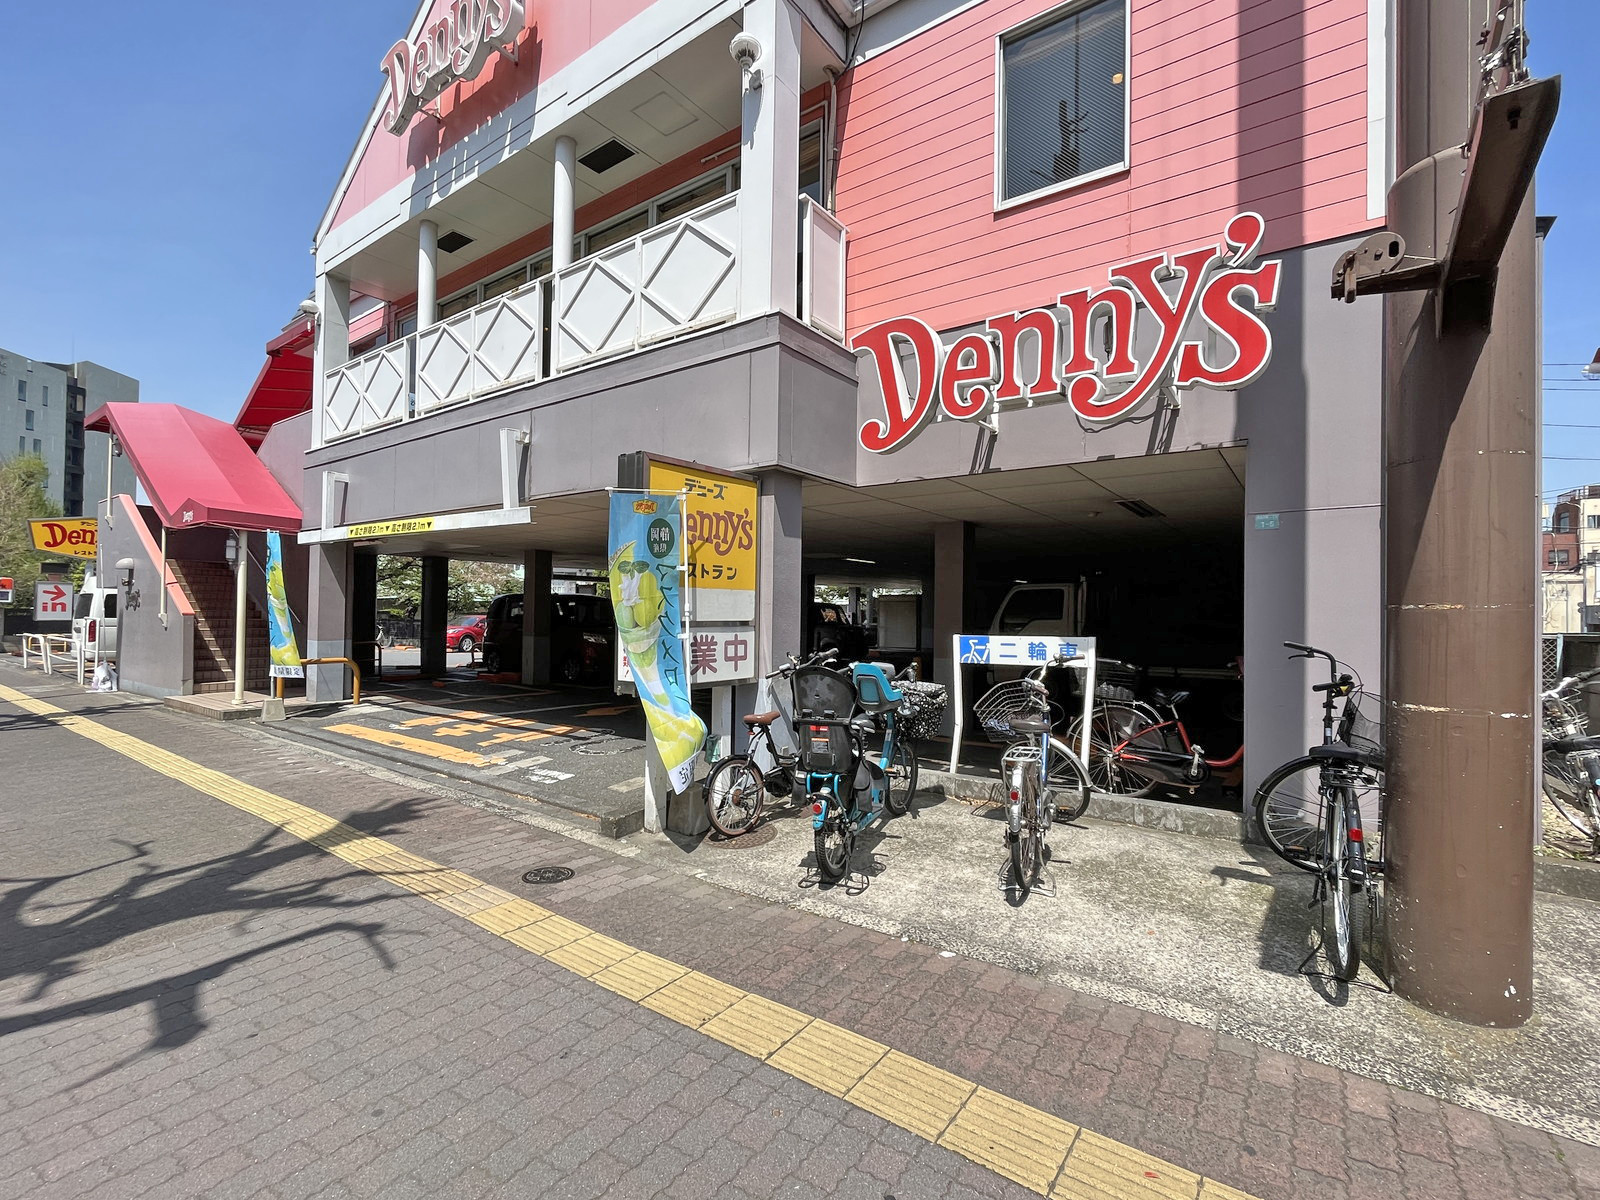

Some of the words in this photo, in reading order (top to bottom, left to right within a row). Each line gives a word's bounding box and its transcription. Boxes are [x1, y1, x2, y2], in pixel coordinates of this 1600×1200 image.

[380, 0, 520, 136] Dennys
[851, 211, 1283, 454] Denny's
[684, 478, 728, 500] デニーズ
[41, 523, 98, 548] Den
[681, 508, 754, 557] enny's
[686, 562, 738, 580] ストラン
[41, 602, 67, 612] in
[689, 633, 748, 675] 業中
[999, 641, 1079, 661] 二輪車
